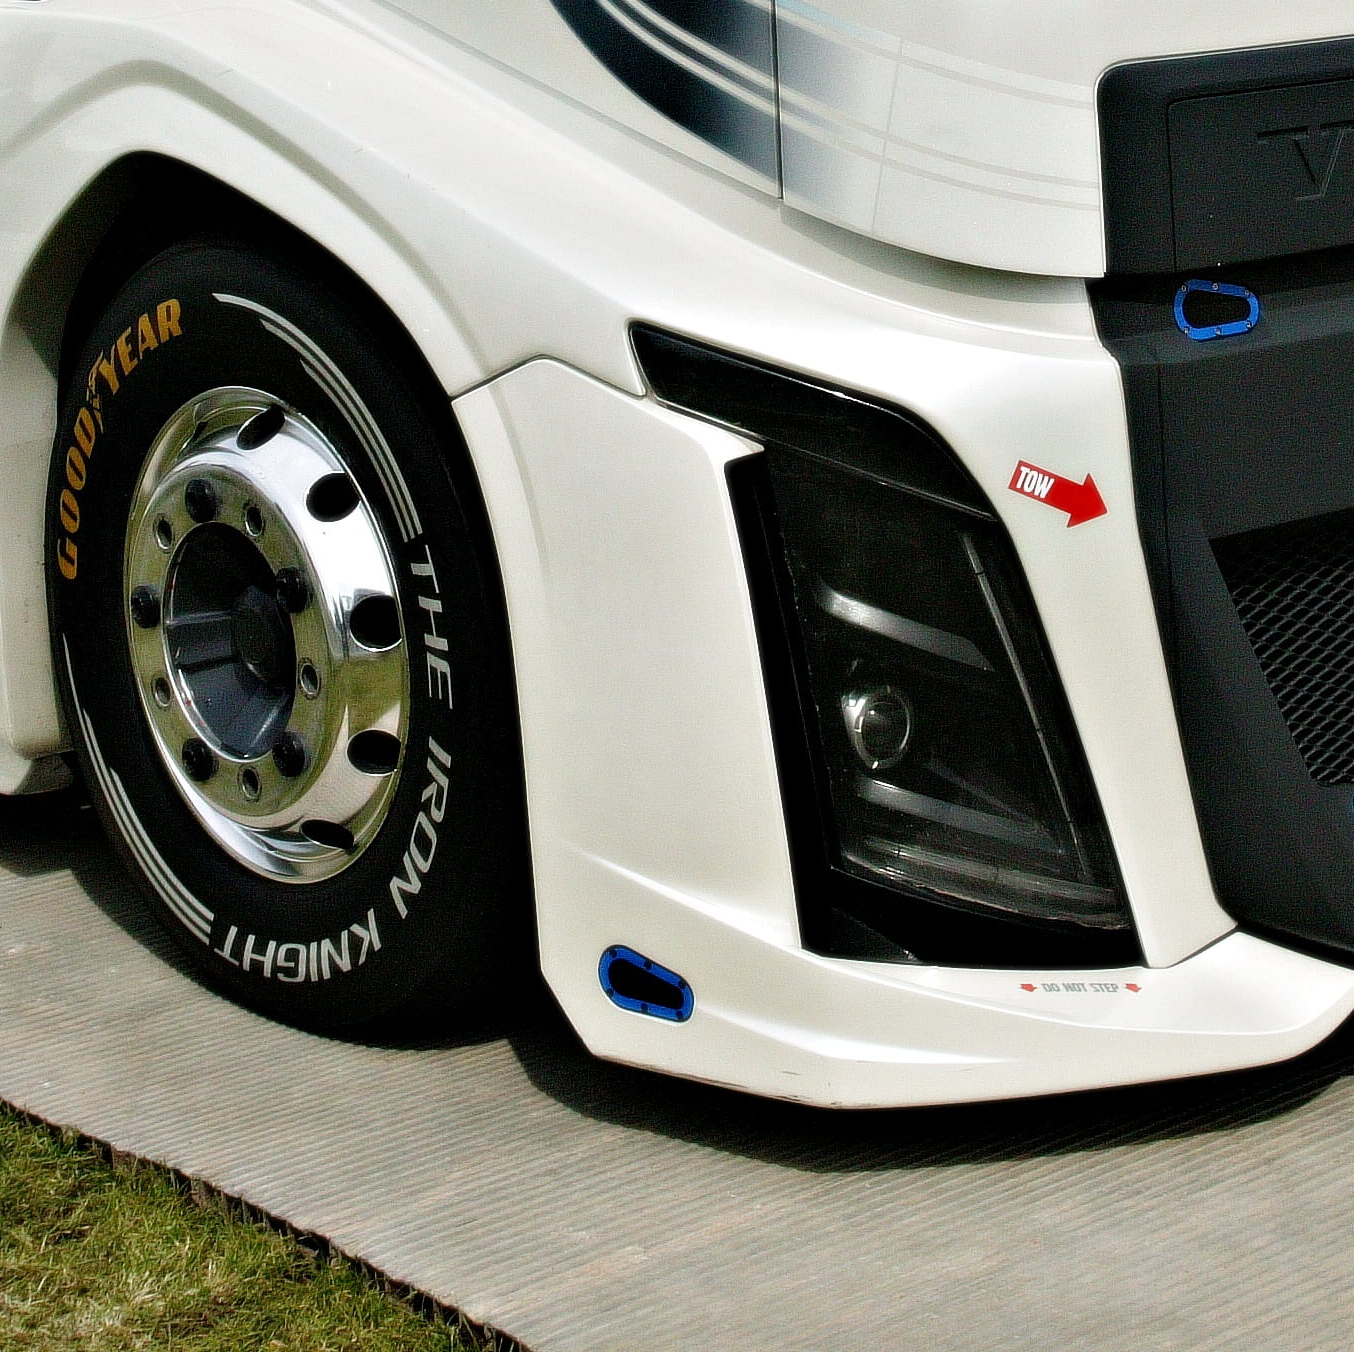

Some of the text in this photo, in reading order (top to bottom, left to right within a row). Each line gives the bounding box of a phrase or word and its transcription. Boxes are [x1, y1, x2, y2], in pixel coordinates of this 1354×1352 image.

[1016, 466, 1055, 498] TOW
[213, 542, 454, 984] THE IRON KNIGHT
[1089, 982, 1120, 993] STEP
